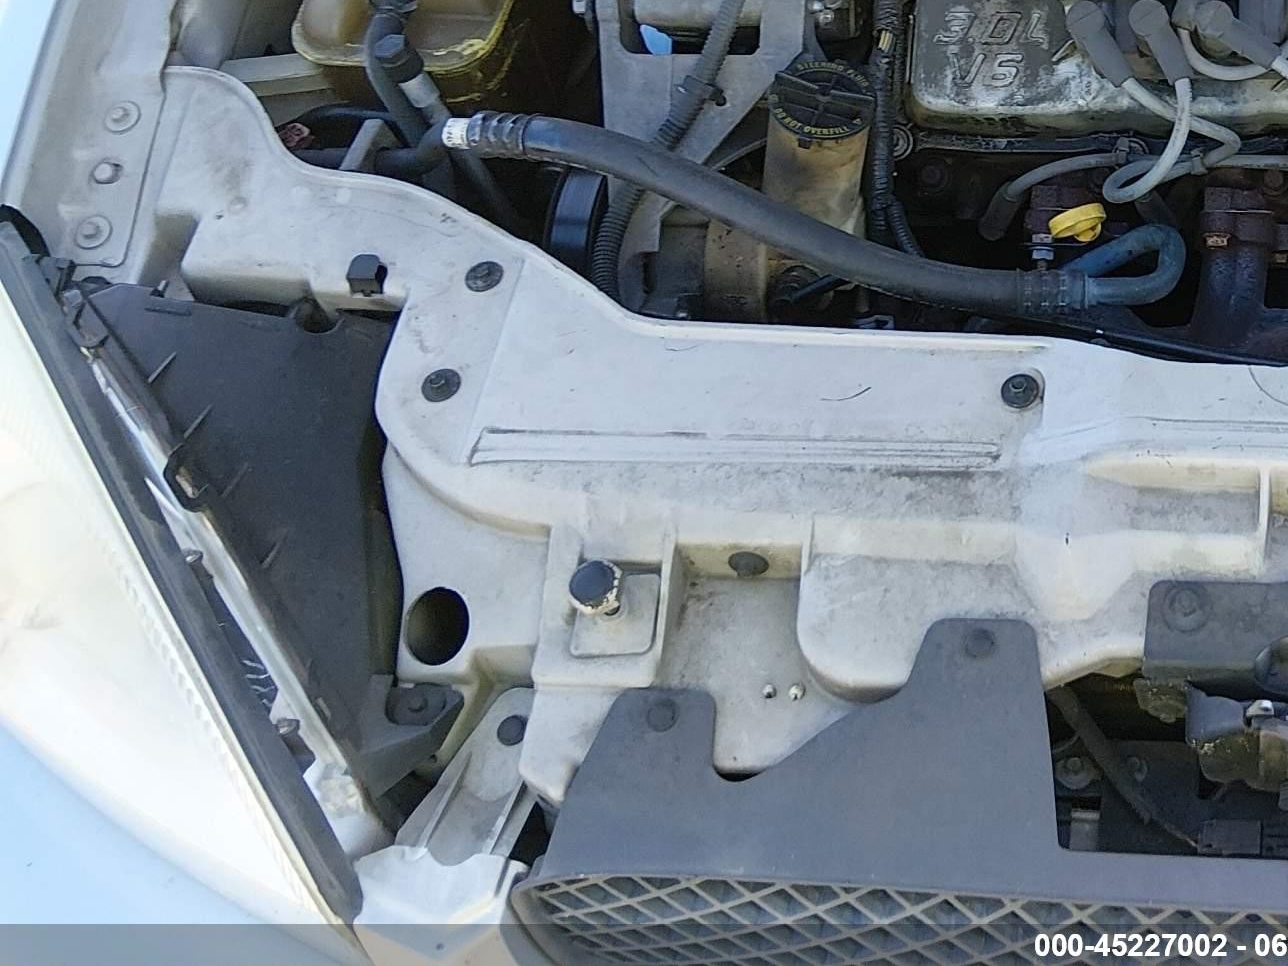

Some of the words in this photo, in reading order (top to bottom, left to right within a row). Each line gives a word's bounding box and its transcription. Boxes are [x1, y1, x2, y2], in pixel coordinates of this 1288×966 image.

[951, 52, 1025, 88] V6
[783, 116, 803, 130] NOT
[802, 124, 850, 136] OVERFILL
